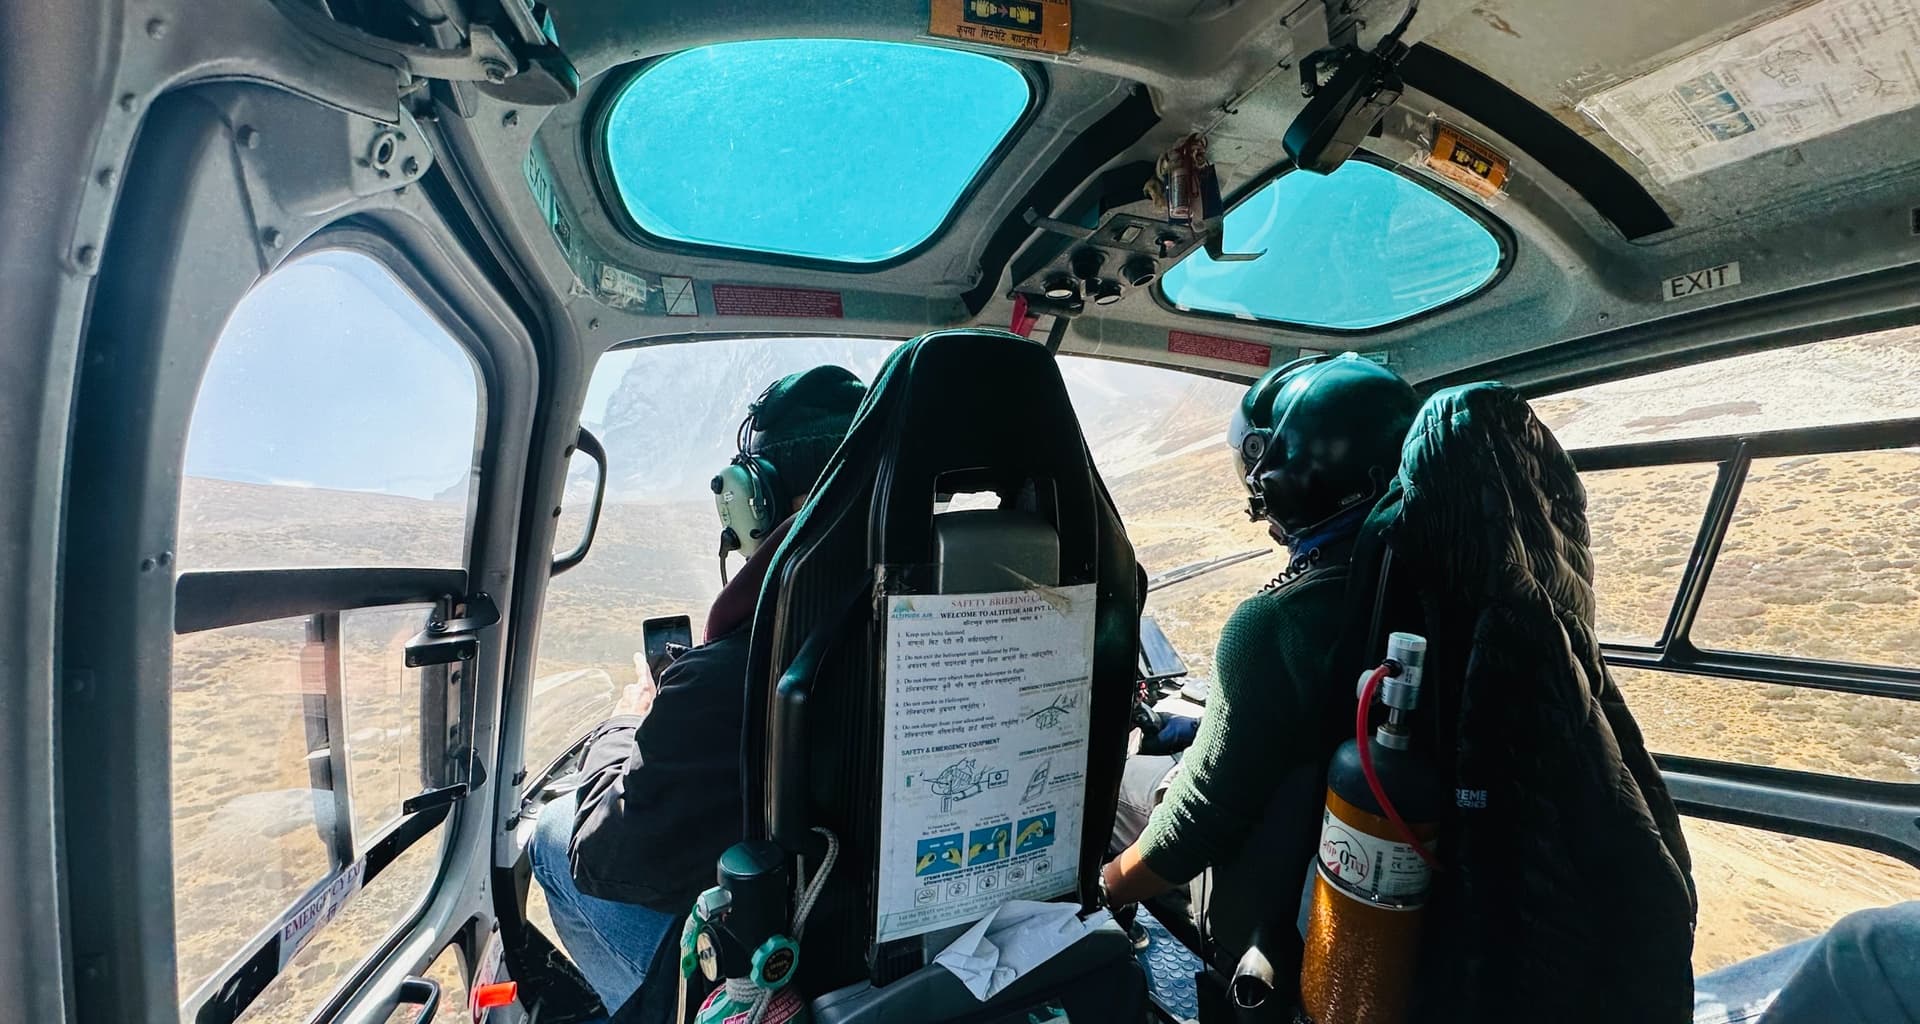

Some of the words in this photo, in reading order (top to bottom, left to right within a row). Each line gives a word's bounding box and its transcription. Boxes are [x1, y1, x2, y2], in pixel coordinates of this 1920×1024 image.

[529, 147, 548, 209] EXIT
[1671, 265, 1729, 297] EXIT
[940, 610, 977, 619] WELCOME
[989, 607, 1020, 616] ALTITUDE
[901, 747, 924, 757] SAFETY
[931, 741, 967, 753] EMERGENCY
[968, 737, 1000, 748] EQUIPMENT
[285, 877, 345, 941] EMERGCY
